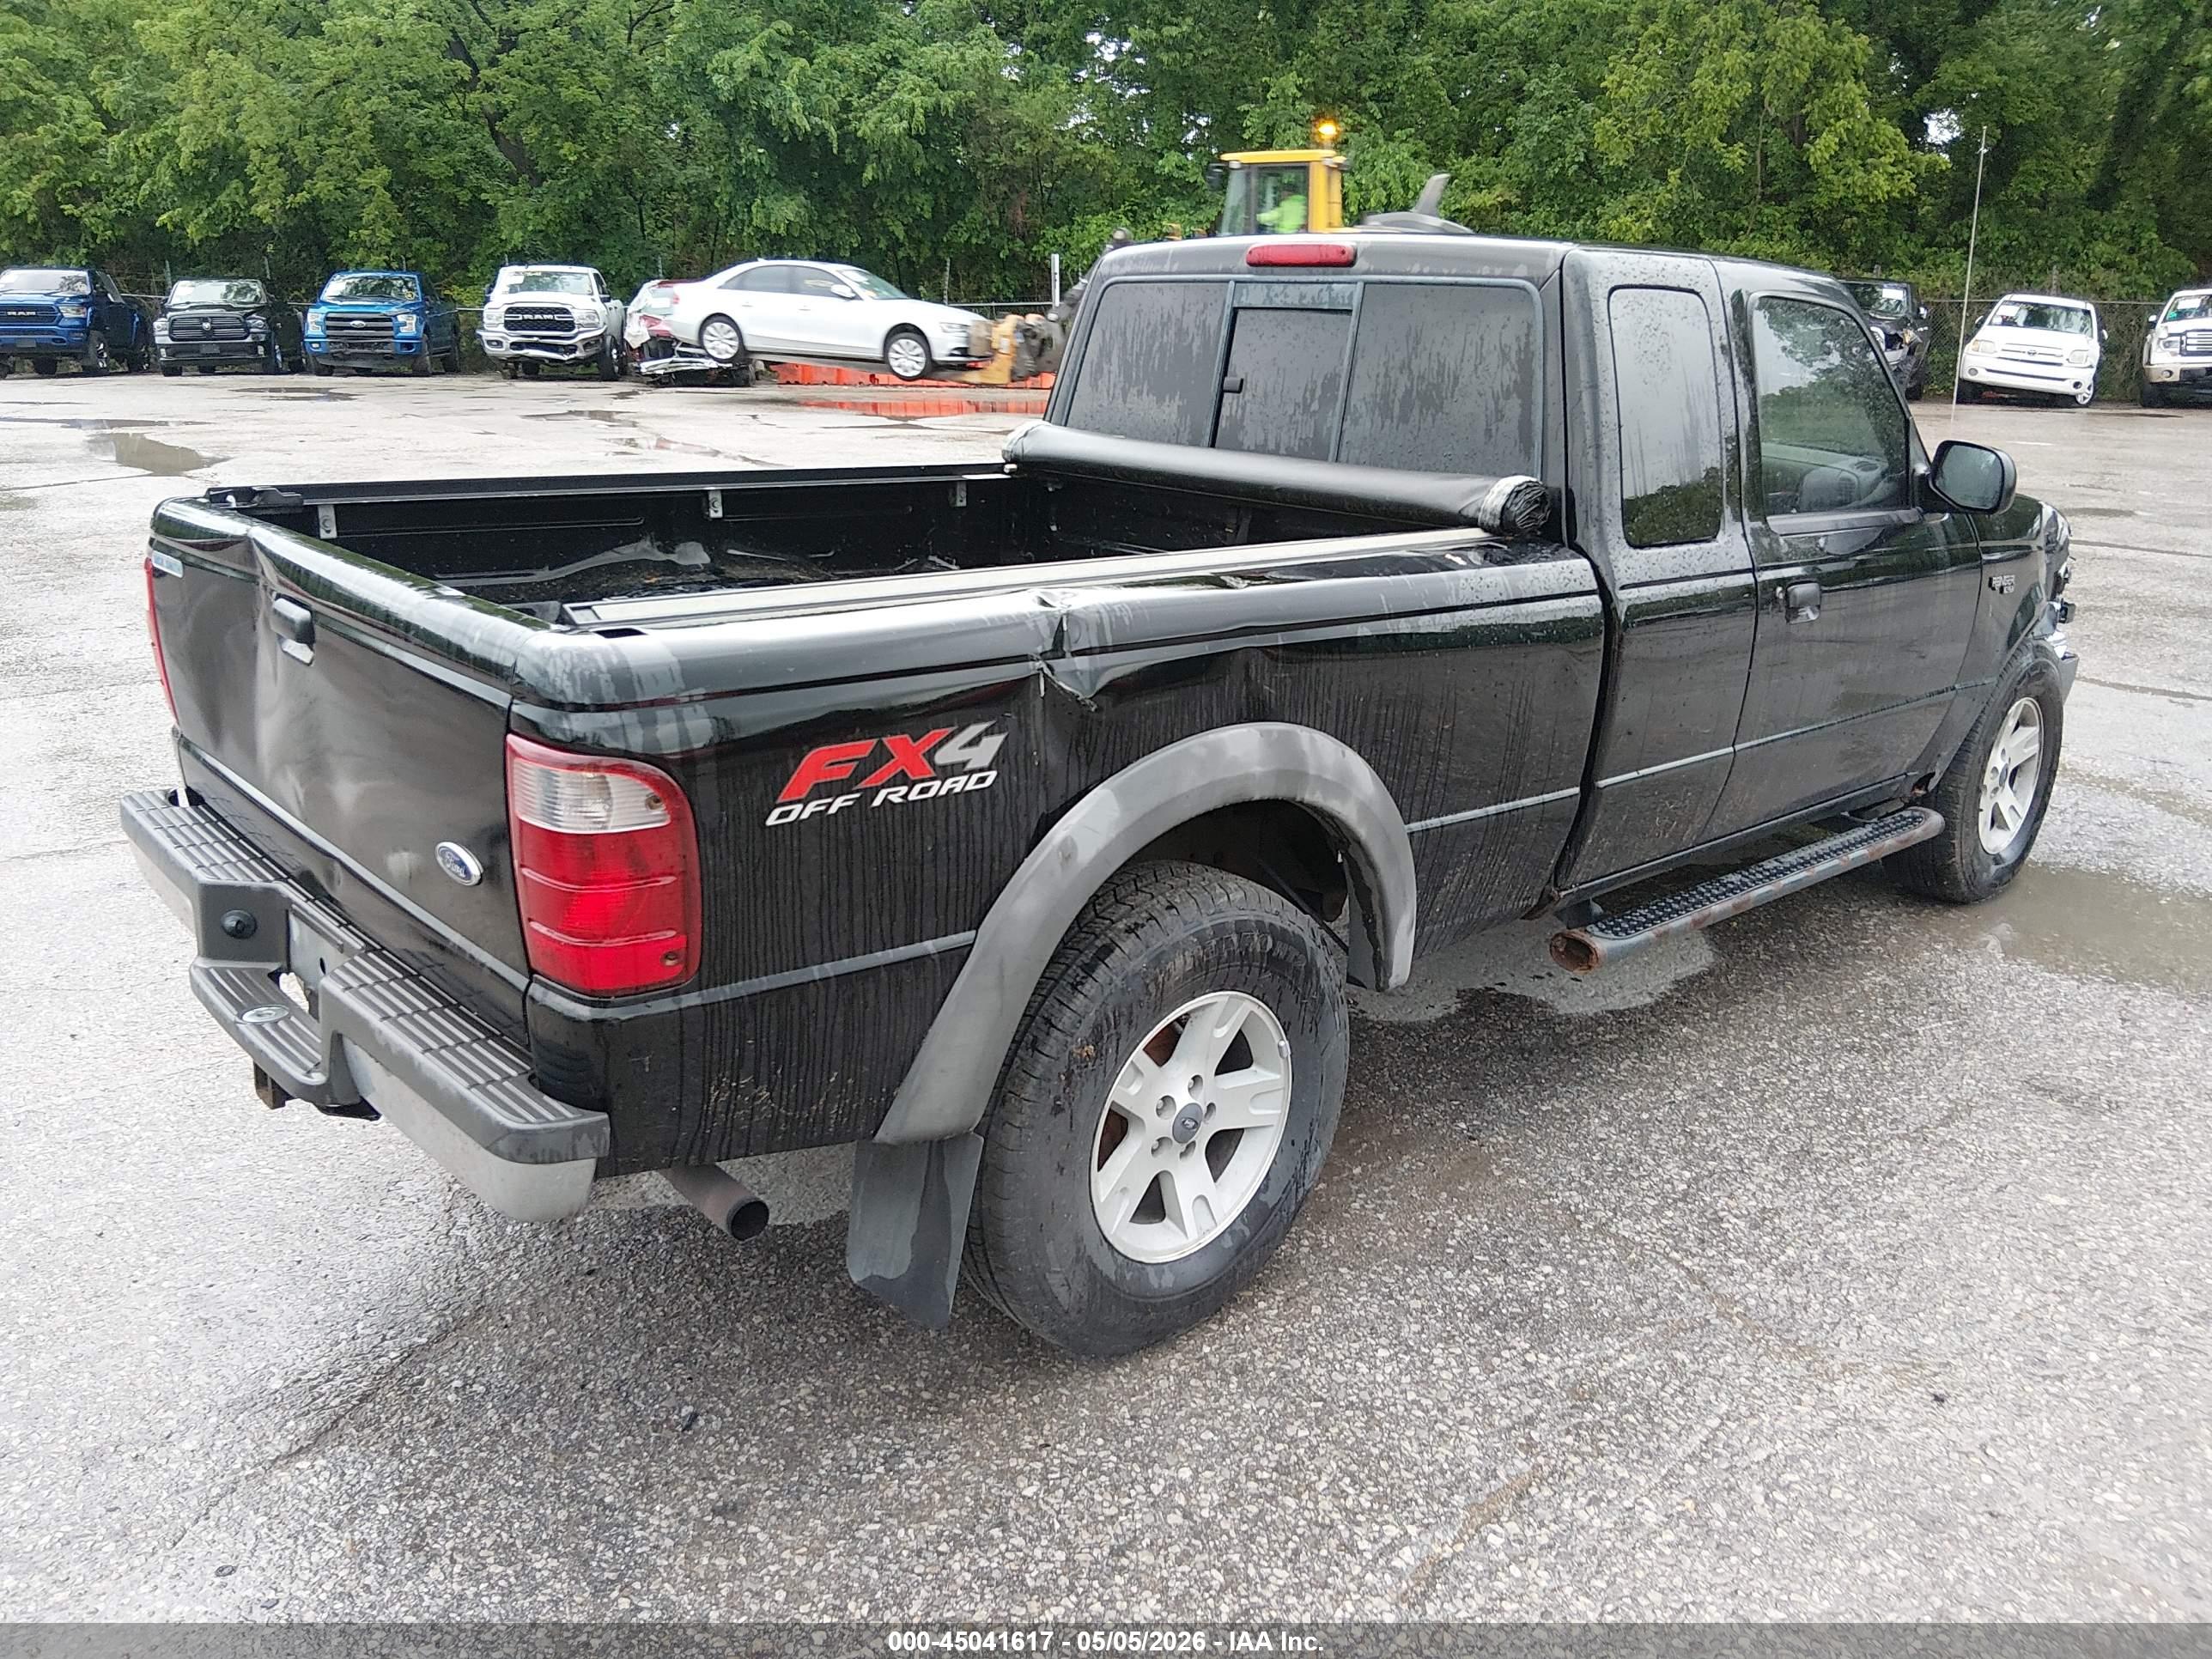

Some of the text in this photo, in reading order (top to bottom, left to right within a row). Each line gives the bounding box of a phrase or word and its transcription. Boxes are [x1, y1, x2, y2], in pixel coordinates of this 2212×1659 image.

[776, 720, 1009, 804] FX4
[765, 769, 998, 827] OFF ROAD
